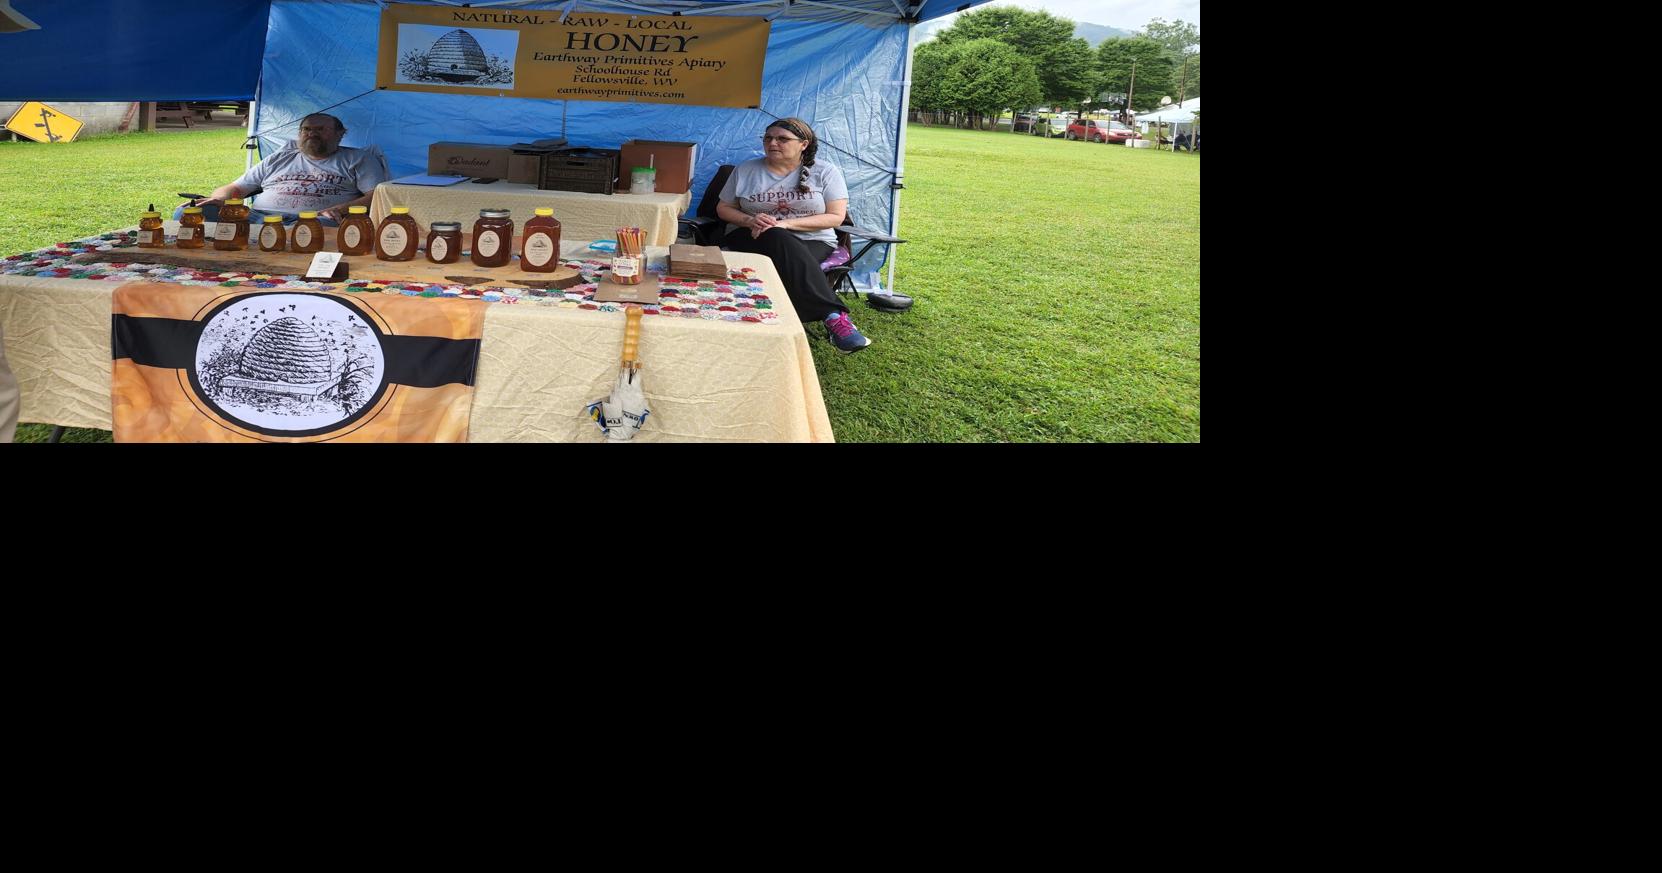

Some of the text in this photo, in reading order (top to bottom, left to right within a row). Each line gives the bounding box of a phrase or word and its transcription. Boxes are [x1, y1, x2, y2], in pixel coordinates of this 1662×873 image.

[453, 12, 544, 25] NATURAL
[562, 15, 609, 28] RAW
[625, 19, 693, 31] LOCAL
[564, 31, 699, 53] HONEY
[533, 52, 727, 72] Earthway Primitives Apiary
[575, 65, 671, 77] Schoolhouse Rd
[653, 78, 678, 86] WV
[557, 87, 685, 99] earthwayprimitives.com
[748, 190, 813, 203] SUPPORT
